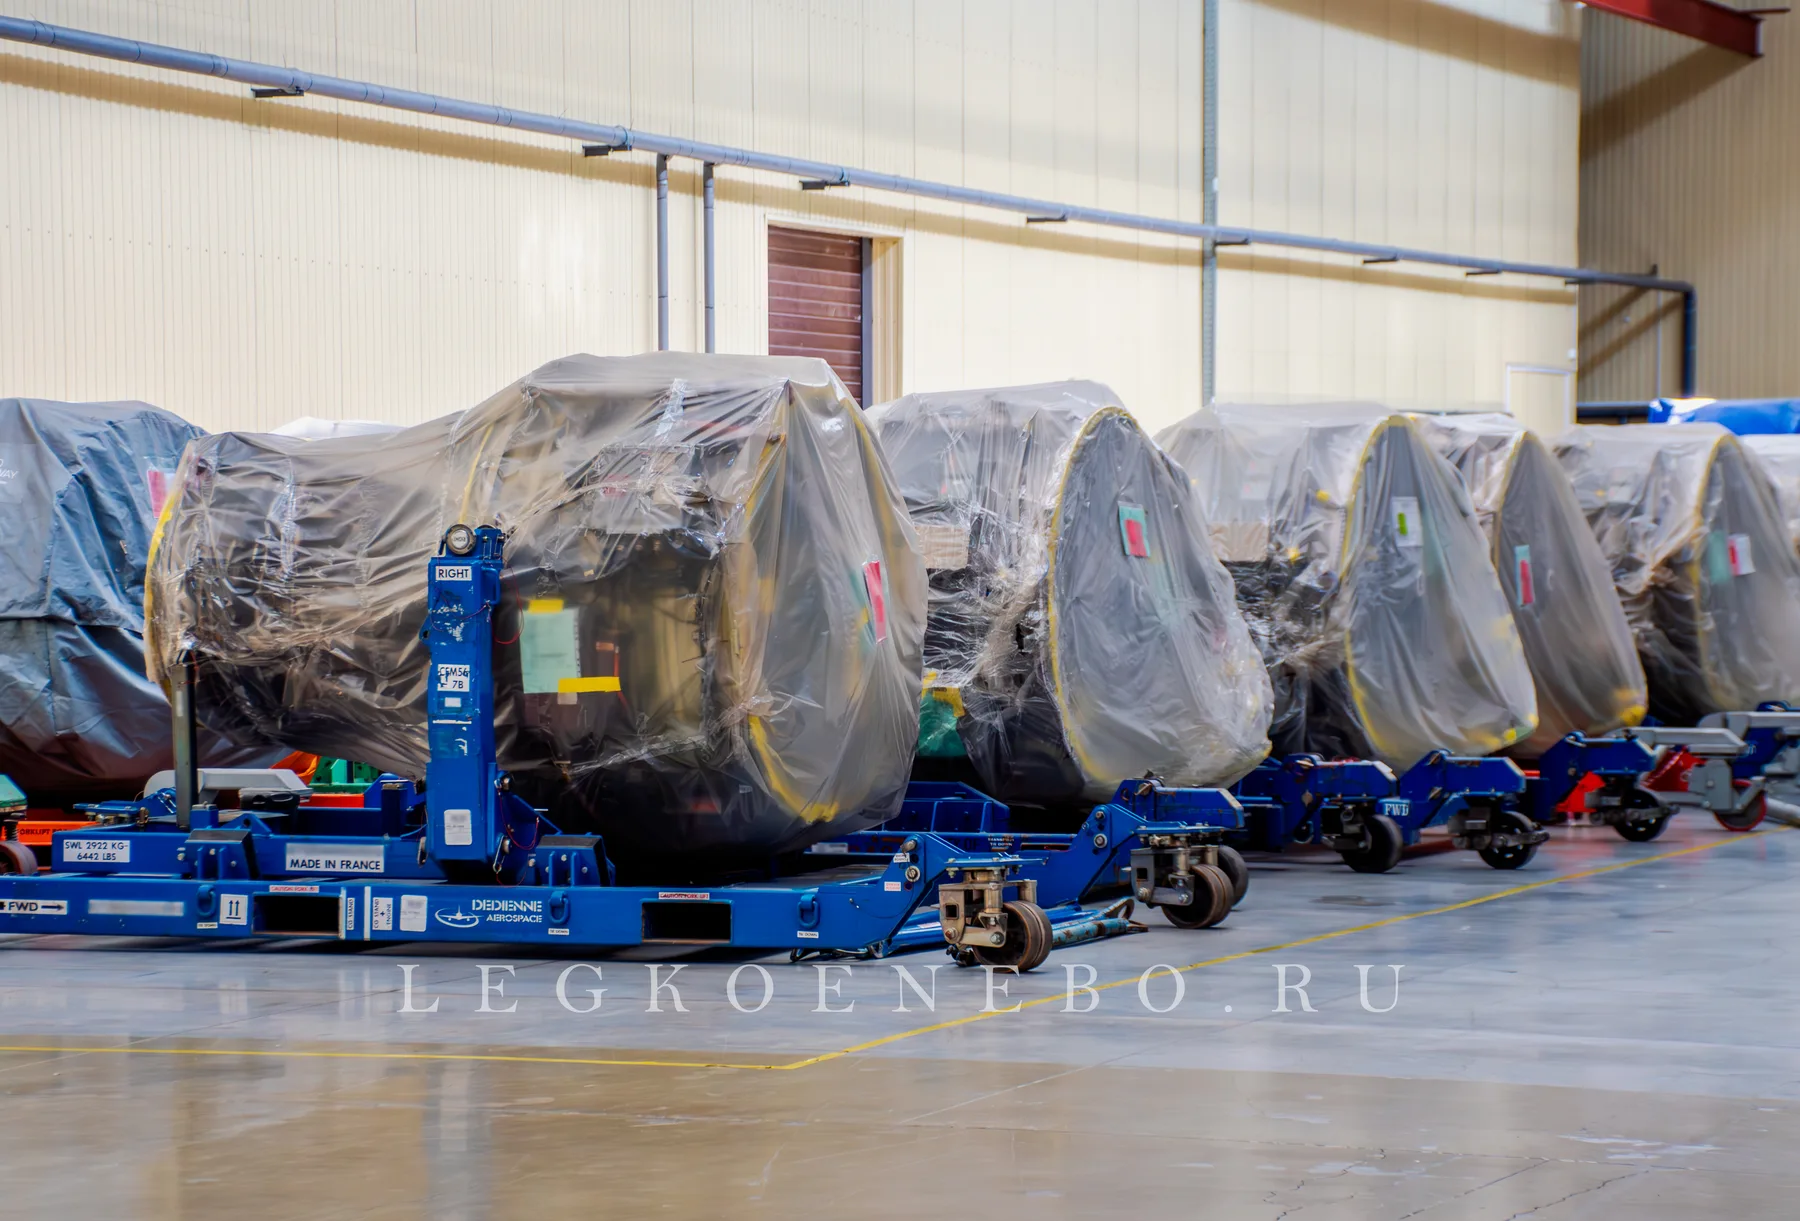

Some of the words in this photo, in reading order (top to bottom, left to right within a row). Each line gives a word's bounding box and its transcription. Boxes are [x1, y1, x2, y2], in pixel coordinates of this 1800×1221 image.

[438, 569, 469, 578] RIGHT
[1385, 803, 1409, 816] FWD
[65, 841, 82, 850] SWL
[86, 841, 108, 850] 2922
[77, 852, 99, 860] 6442
[102, 853, 117, 861] LBS
[290, 859, 321, 869] MADE
[325, 860, 336, 869] IN
[340, 860, 381, 870] FRANCE
[8, 902, 38, 912] FWD
[472, 899, 542, 912] DEDIENNE
[486, 914, 542, 923] AEROSPACE
